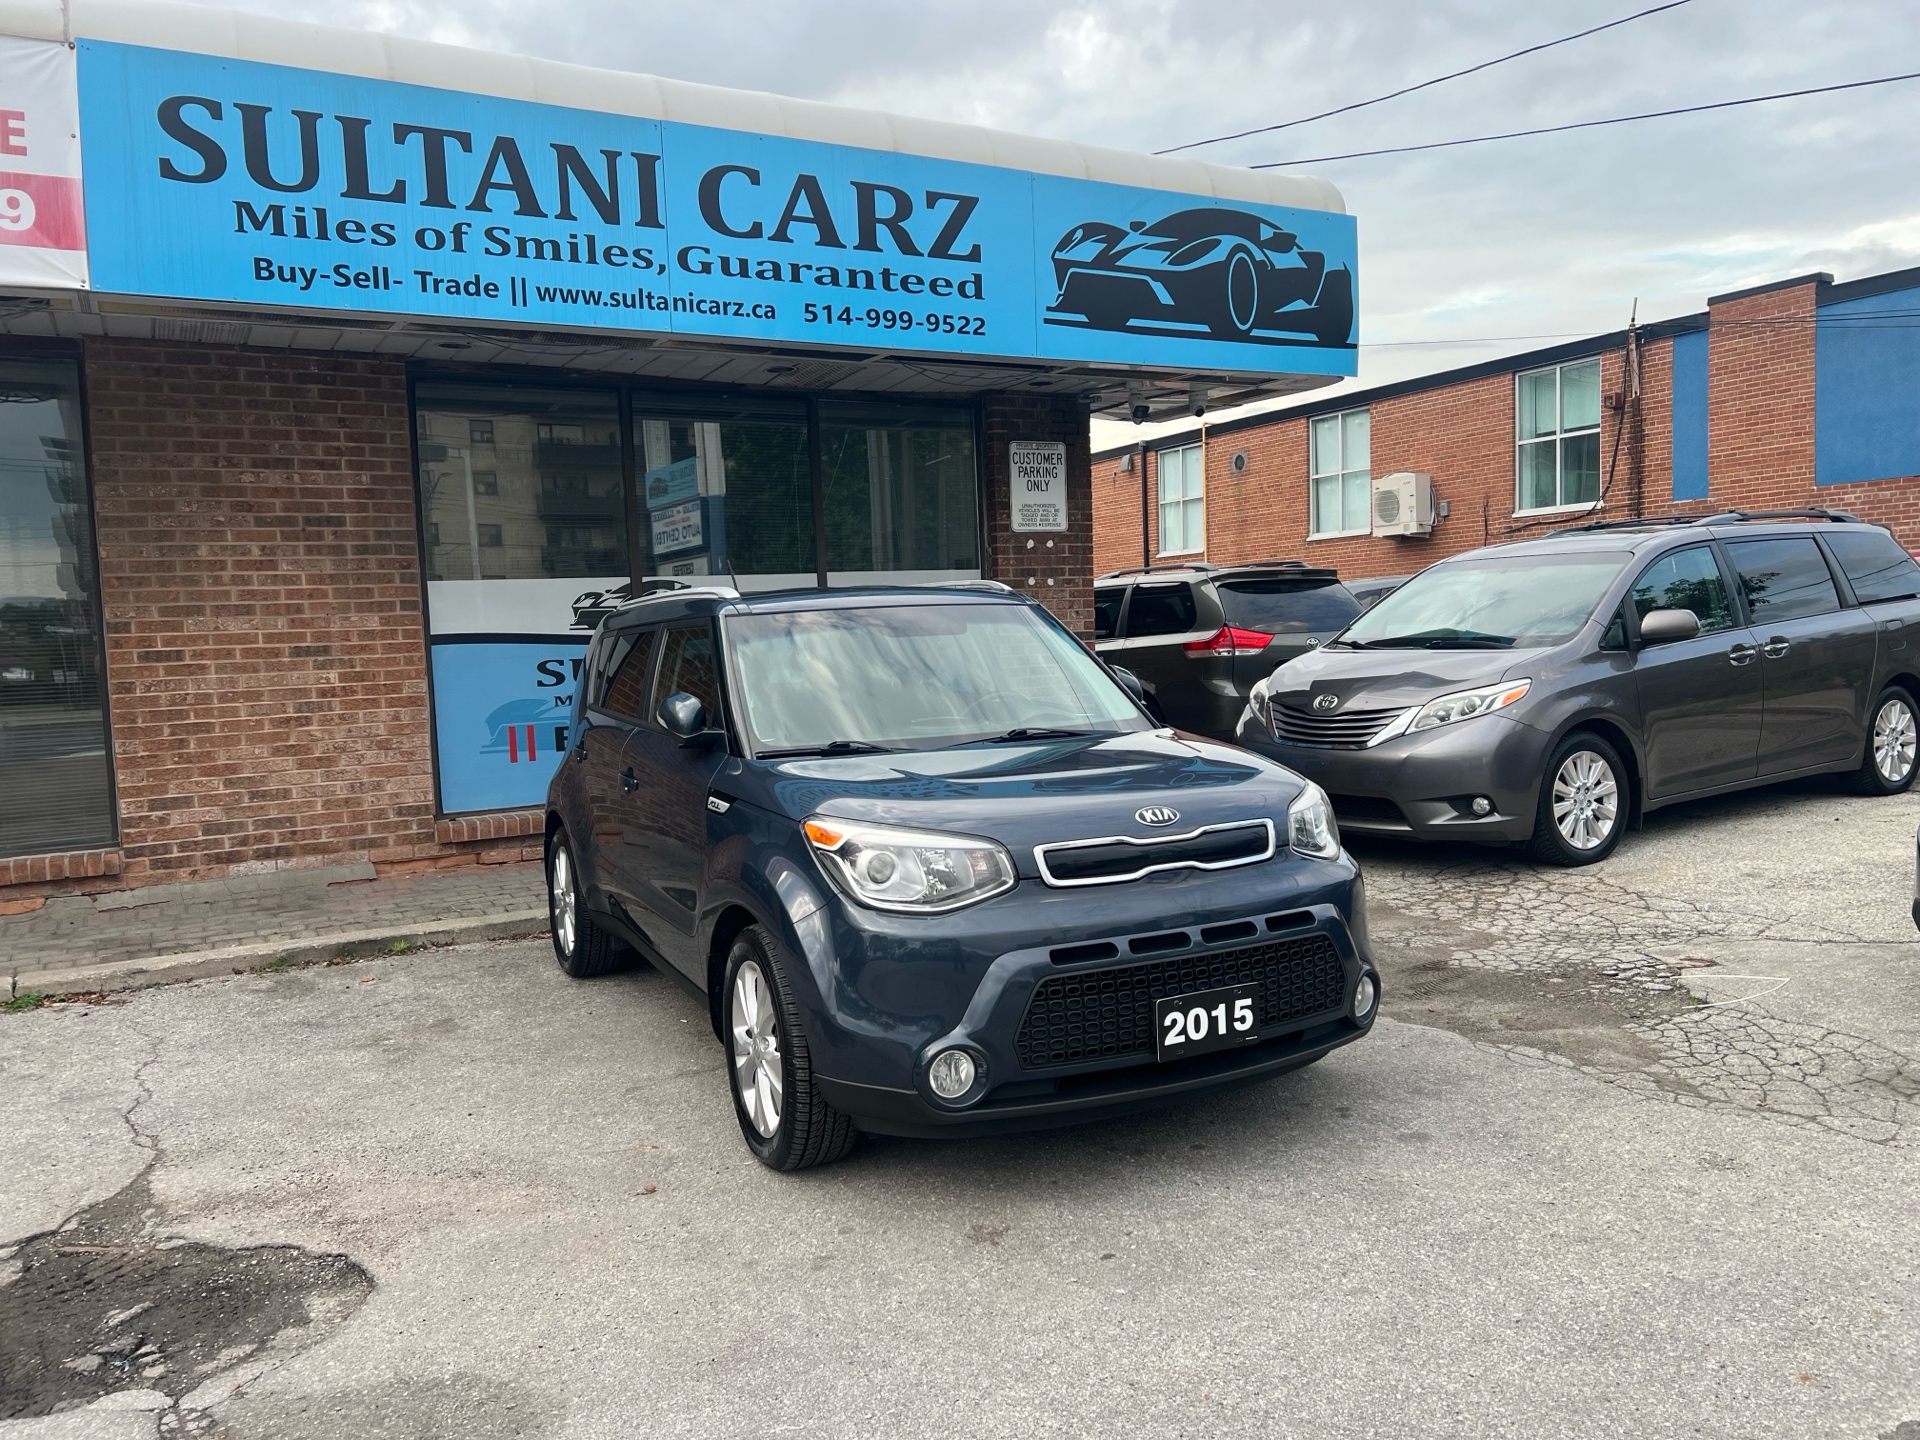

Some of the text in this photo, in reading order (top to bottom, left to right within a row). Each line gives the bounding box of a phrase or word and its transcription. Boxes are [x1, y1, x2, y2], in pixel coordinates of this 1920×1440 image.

[157, 94, 982, 263] SULTANI CARZ
[232, 200, 985, 300] Miles of Smiles, Guaranteed
[414, 270, 500, 299] Trade
[535, 284, 777, 321] www.sultanicarz.ca
[804, 303, 986, 336] 514-999-9522
[1012, 451, 1063, 466] CUSTOMER
[1018, 465, 1058, 479] PARKING
[1026, 479, 1050, 492] ONLY
[1142, 808, 1175, 823] KIA
[1163, 998, 1254, 1046] 2015
